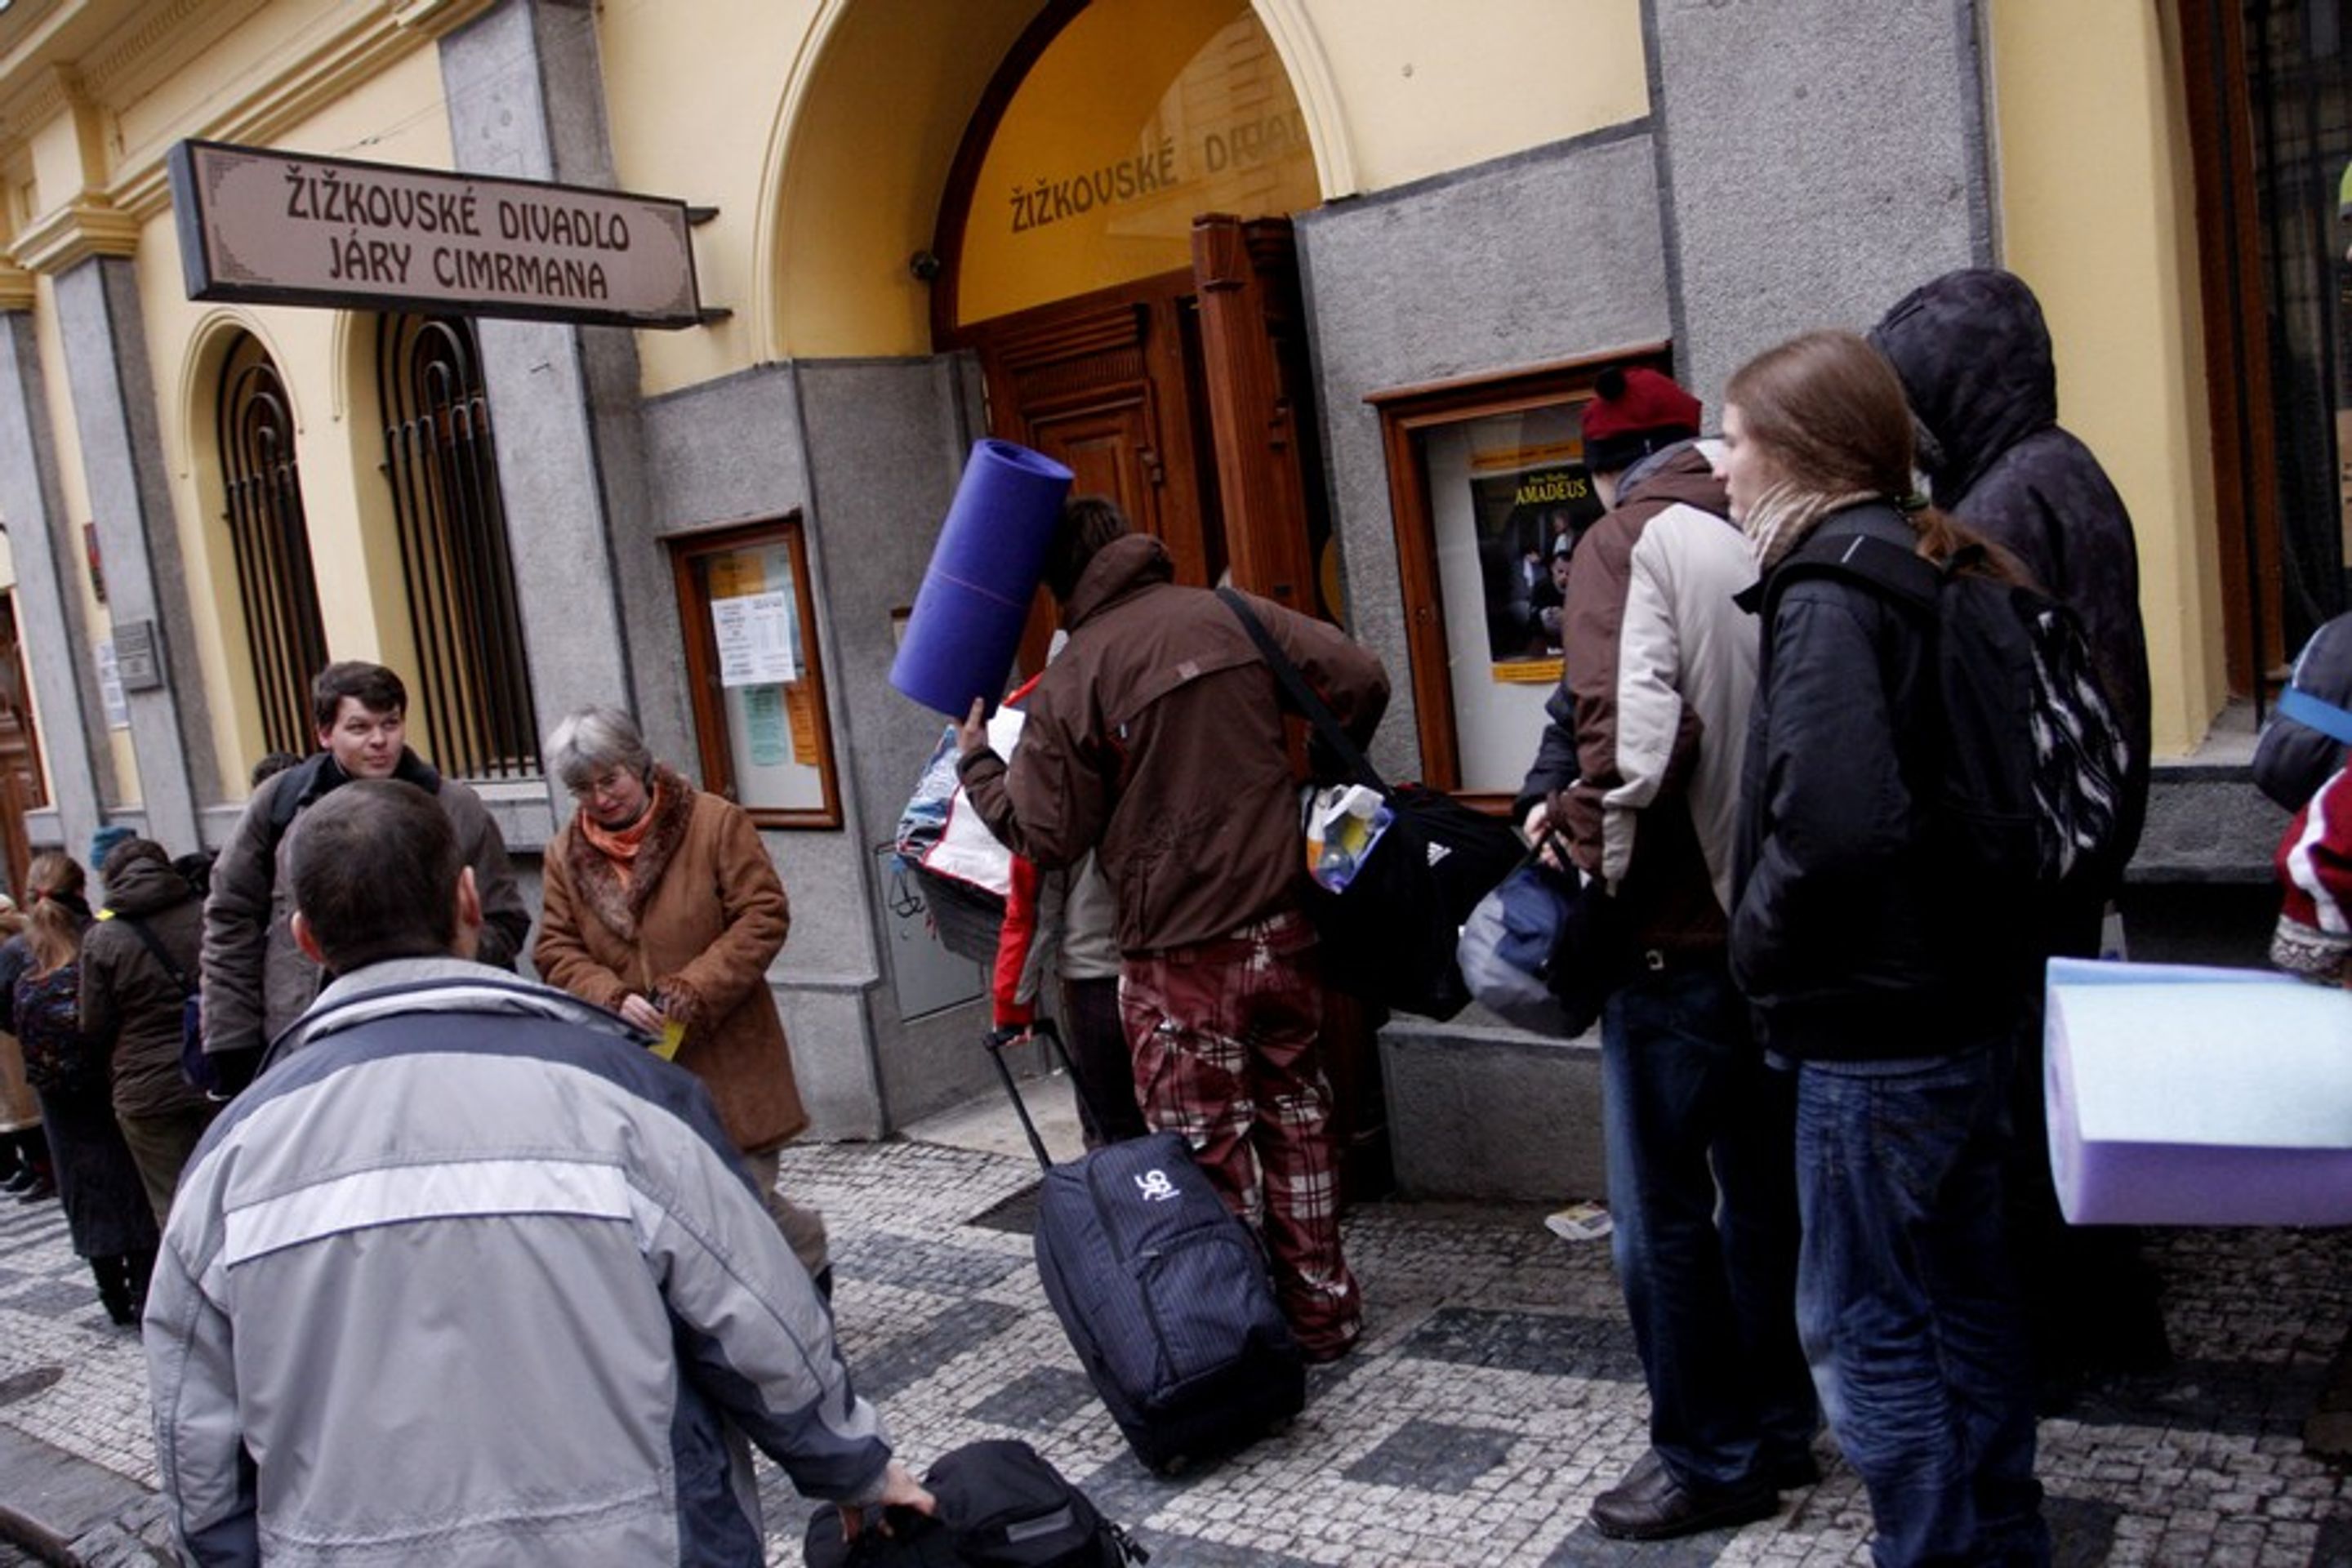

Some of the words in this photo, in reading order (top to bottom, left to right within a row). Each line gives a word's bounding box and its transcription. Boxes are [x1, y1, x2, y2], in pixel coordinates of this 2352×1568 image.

[285, 164, 481, 237] ŽIŽKOVSKÉ
[499, 201, 630, 252] DIVADLO
[1010, 138, 1178, 234] ŽIŽKOVSKÉ
[330, 229, 411, 283] JÁRY
[434, 247, 608, 300] CIMRMANA
[1515, 479, 1588, 506] AMADEUS
